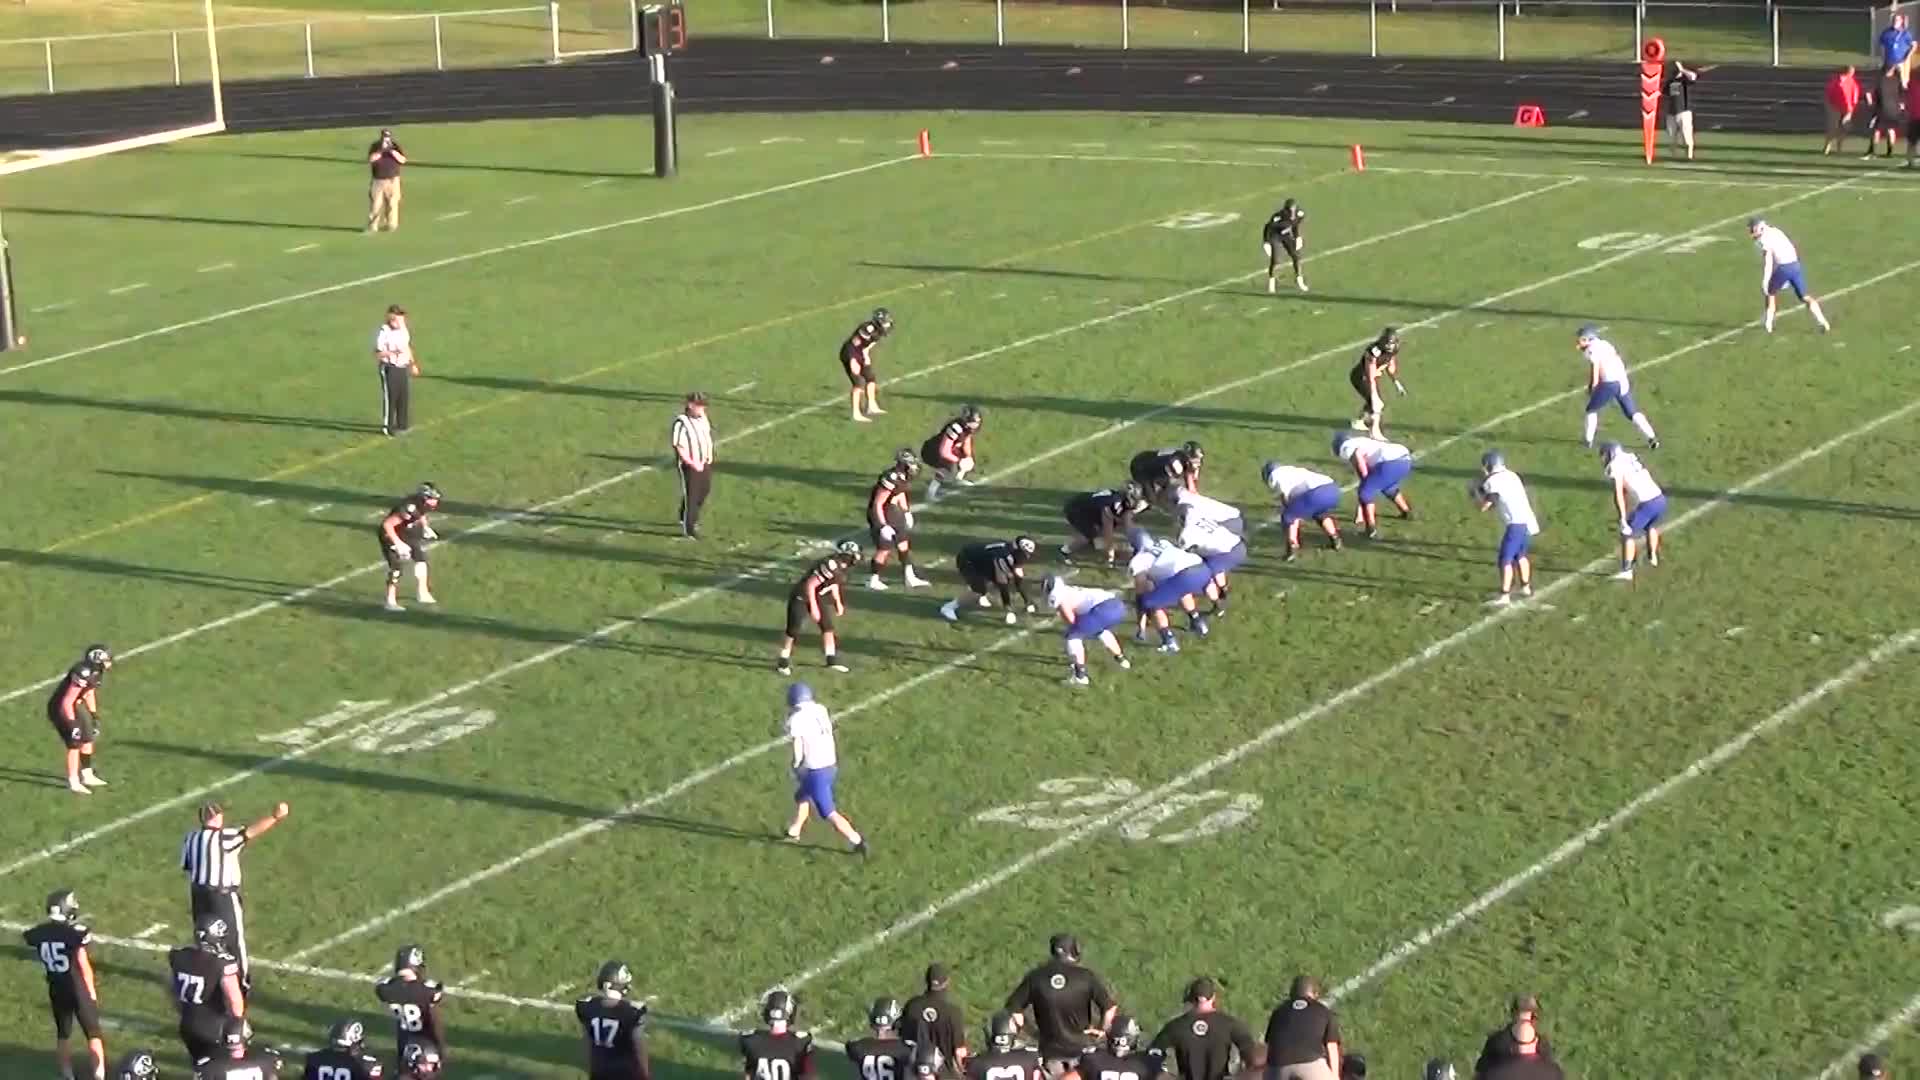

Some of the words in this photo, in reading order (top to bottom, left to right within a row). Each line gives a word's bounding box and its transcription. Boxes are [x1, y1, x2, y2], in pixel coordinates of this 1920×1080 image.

[39, 941, 70, 973] 45
[177, 972, 205, 1004] 77
[591, 1017, 620, 1048] 17
[754, 1057, 791, 1080] 40
[861, 1055, 895, 1080] 46
